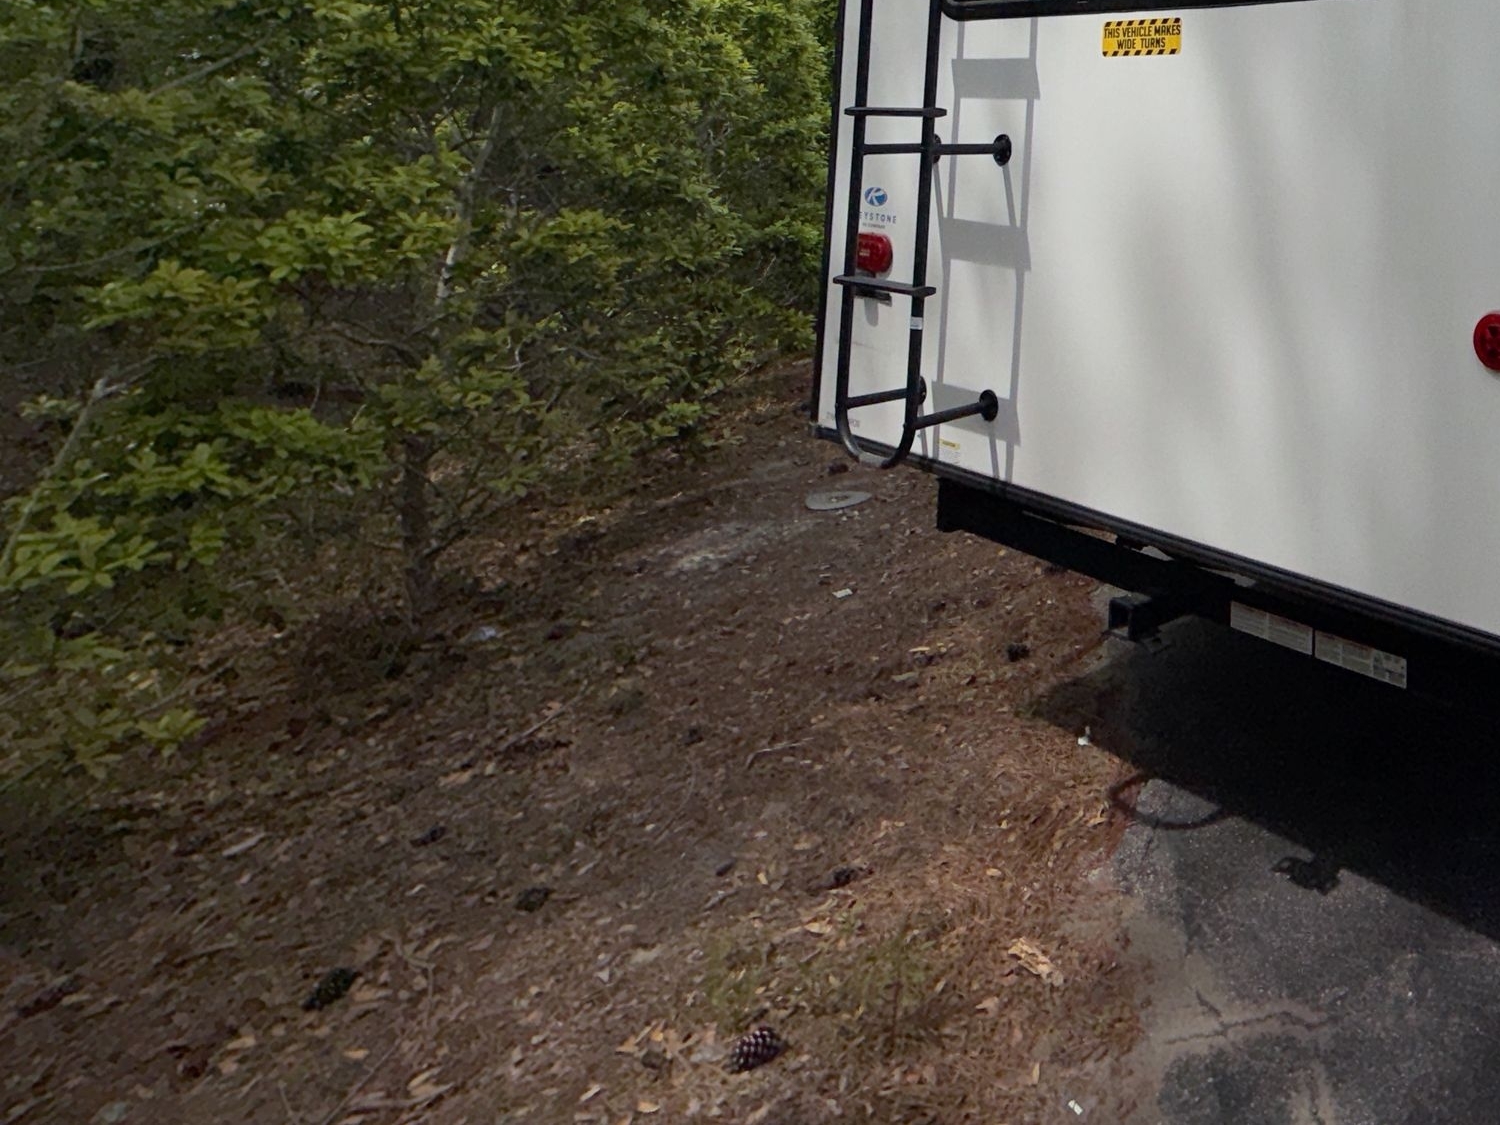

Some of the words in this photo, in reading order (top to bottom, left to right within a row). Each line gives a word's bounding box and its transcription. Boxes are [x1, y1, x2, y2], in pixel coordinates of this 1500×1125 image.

[1104, 28, 1120, 39] THIS
[1122, 26, 1152, 38] VEHICLE
[1154, 24, 1181, 36] MAKES
[1117, 38, 1136, 49] WIDE
[1140, 37, 1166, 49] TURNS
